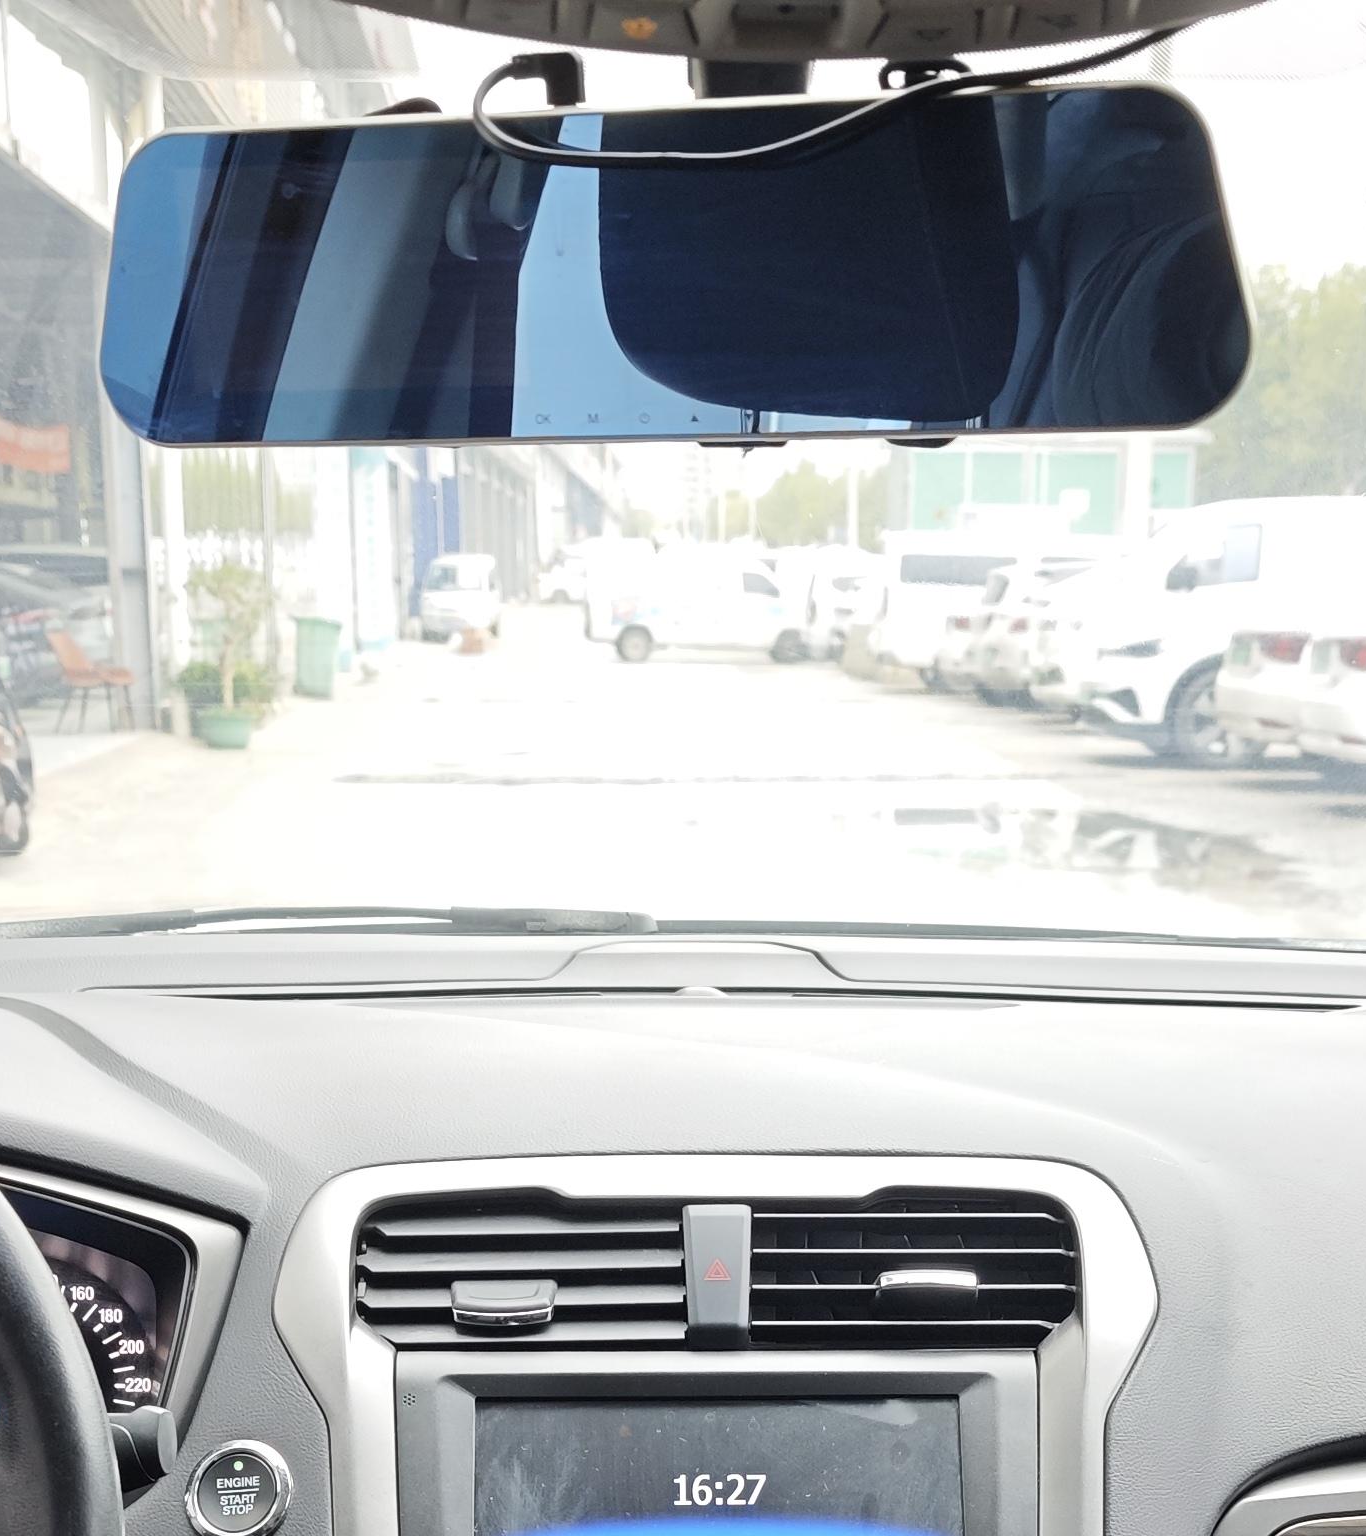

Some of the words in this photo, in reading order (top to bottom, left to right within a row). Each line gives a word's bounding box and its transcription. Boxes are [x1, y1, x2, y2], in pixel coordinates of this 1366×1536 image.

[70, 1285, 95, 1301] 160
[98, 1308, 123, 1323] 180
[118, 1339, 145, 1355] 200
[124, 1377, 152, 1393] 220
[216, 1475, 261, 1489] ENGINE
[673, 1473, 767, 1506] 16:27
[220, 1493, 257, 1506] START
[222, 1504, 254, 1516] STOP
